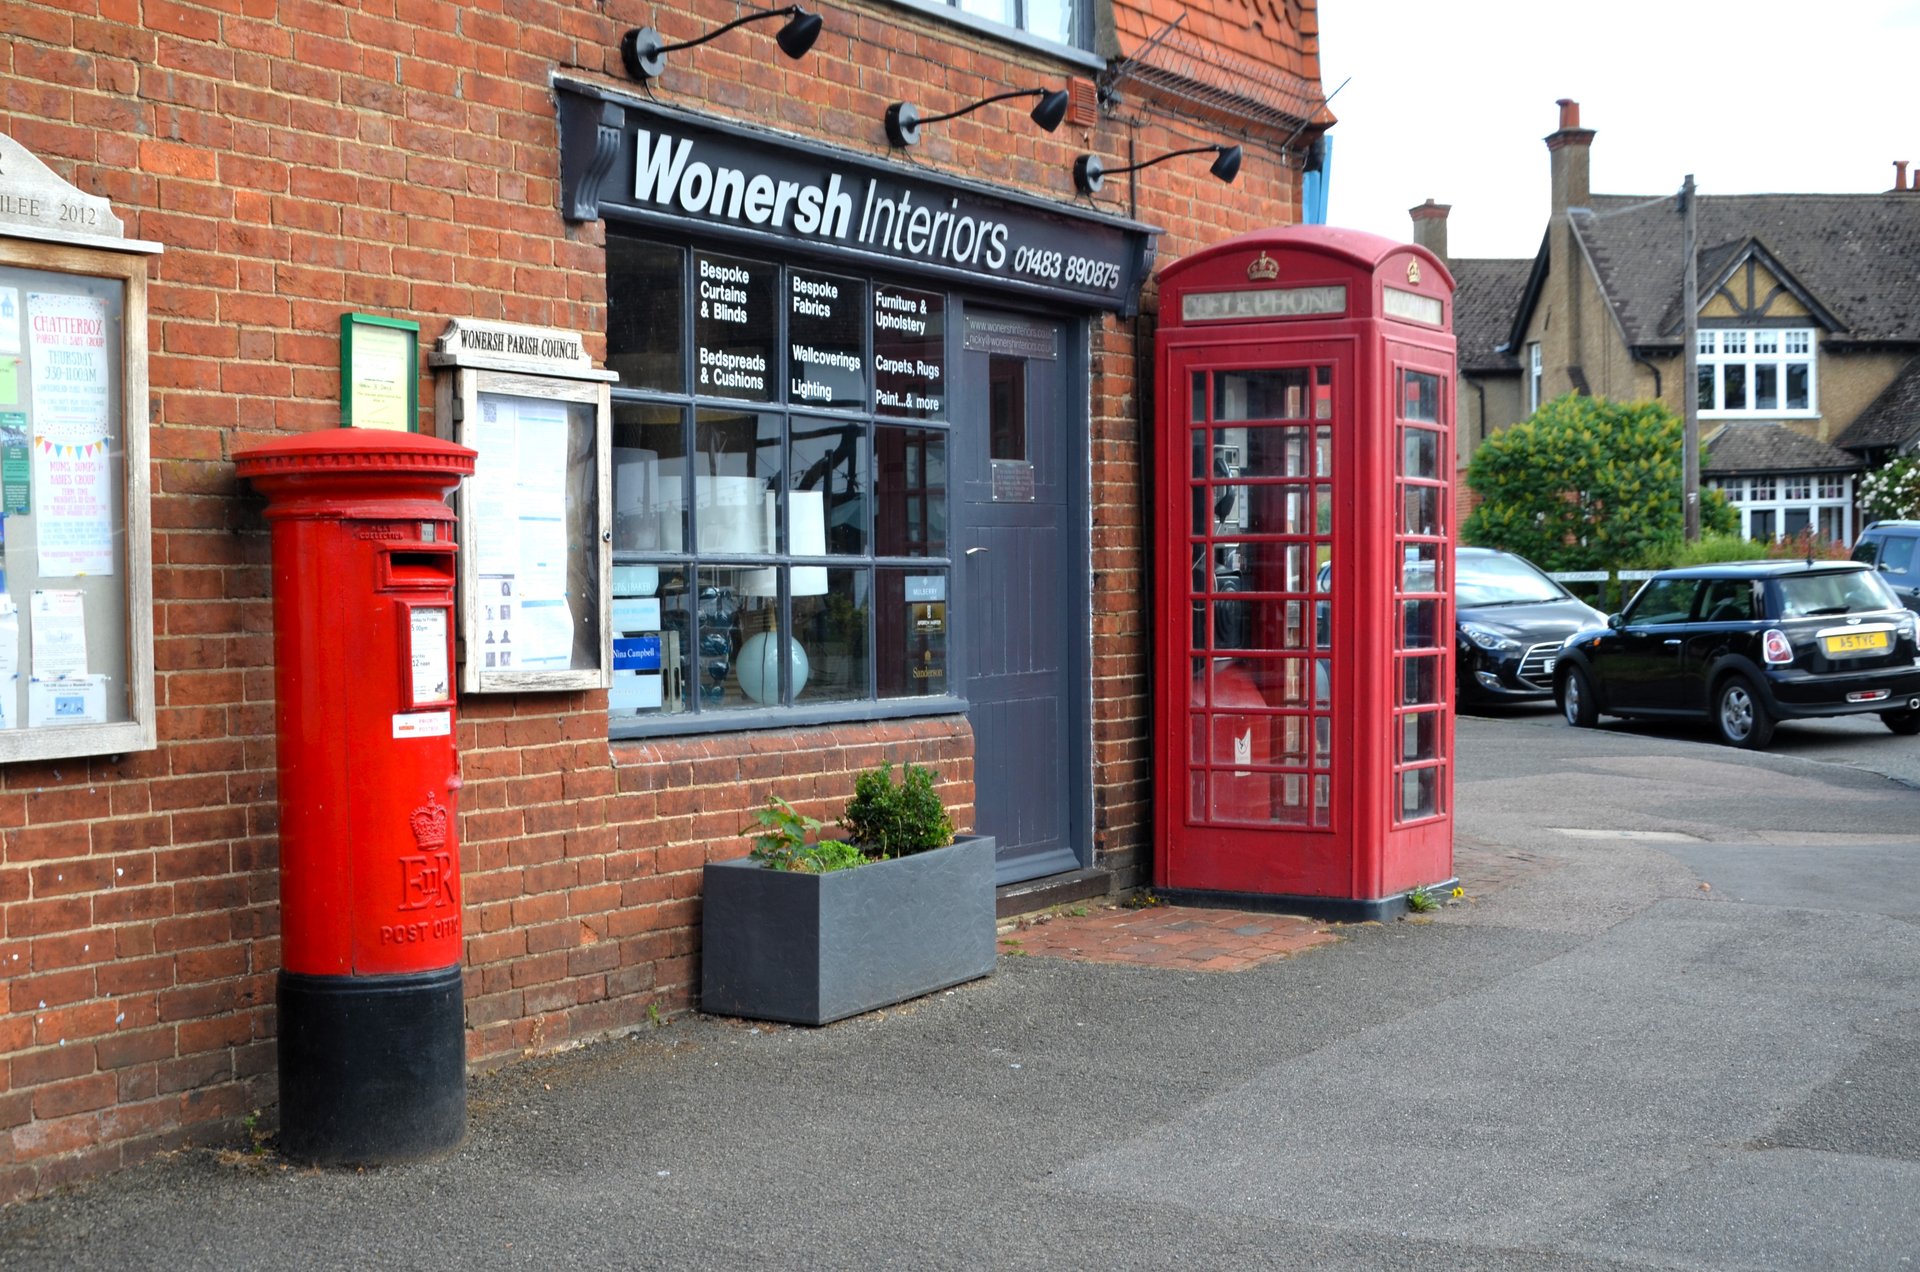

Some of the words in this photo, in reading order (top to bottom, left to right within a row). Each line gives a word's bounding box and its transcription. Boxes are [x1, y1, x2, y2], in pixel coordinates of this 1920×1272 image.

[60, 203, 96, 225] 2012
[634, 128, 853, 239] Wonersh
[858, 178, 1009, 270] Interiors
[1014, 246, 1062, 279] 01483
[1065, 255, 1120, 290] 890875
[700, 260, 750, 285] Bespoke
[700, 281, 747, 304] Curtains
[793, 276, 838, 299] Bespoke
[700, 301, 710, 319] &
[714, 302, 748, 324] Blinds
[793, 297, 831, 318] Fabrics
[875, 291, 916, 313] Furniture
[920, 299, 927, 315] &
[1186, 288, 1339, 318] TELEPHONE
[33, 315, 103, 336] CHATTERBOX
[875, 311, 926, 336] Upholstery
[460, 329, 504, 352] WONERSH
[507, 334, 539, 355] PARISH
[541, 339, 579, 361] COUNCIL
[700, 347, 766, 372] Bedspreads
[792, 344, 861, 372] Wallcoverings
[875, 354, 915, 377] Carpets,
[917, 360, 940, 380] Rugs
[700, 367, 709, 384] &
[713, 368, 764, 390] Cushions
[791, 378, 832, 402] Lighting
[916, 396, 939, 411] more
[613, 649, 627, 658] Nina
[627, 648, 655, 660] Campbell
[912, 665, 944, 679] Sanderson
[380, 921, 428, 946] POST
